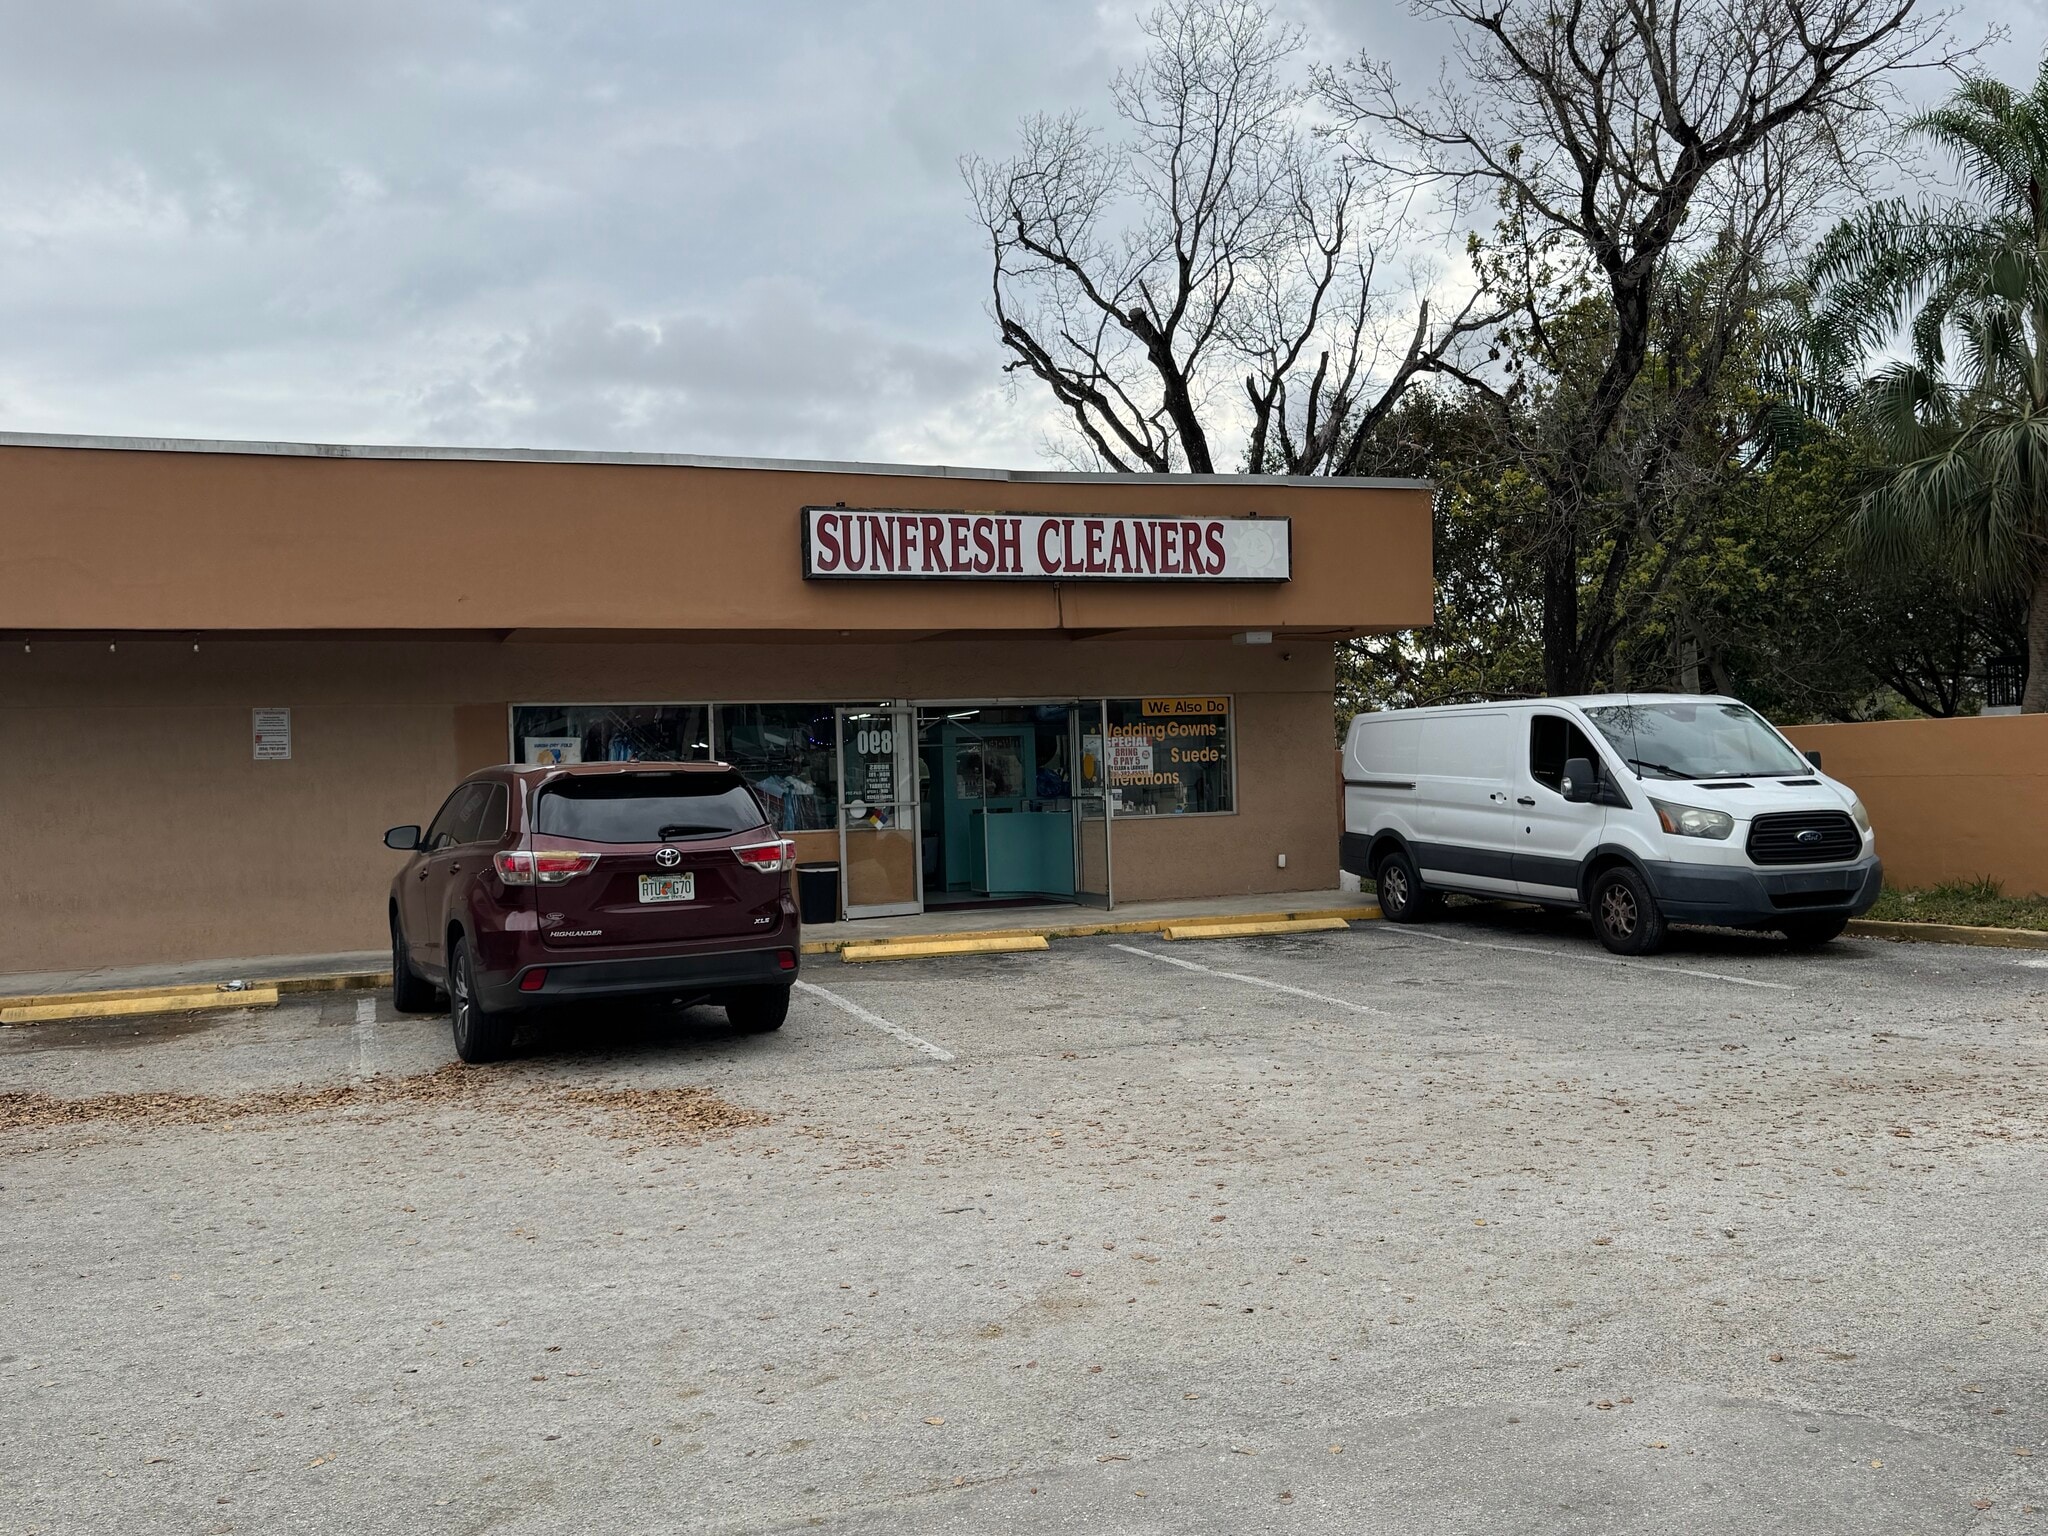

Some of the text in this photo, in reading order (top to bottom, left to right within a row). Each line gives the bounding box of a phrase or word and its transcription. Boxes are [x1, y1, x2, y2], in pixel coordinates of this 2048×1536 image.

[816, 513, 1226, 575] SUNFRESH CLEANERS
[1175, 701, 1202, 713] Also
[1207, 700, 1224, 712] Do
[1167, 721, 1217, 737] Gowns
[1115, 748, 1138, 757] BRING
[1113, 756, 1141, 765] 6 PAY 5
[642, 880, 691, 896] RTU G70
